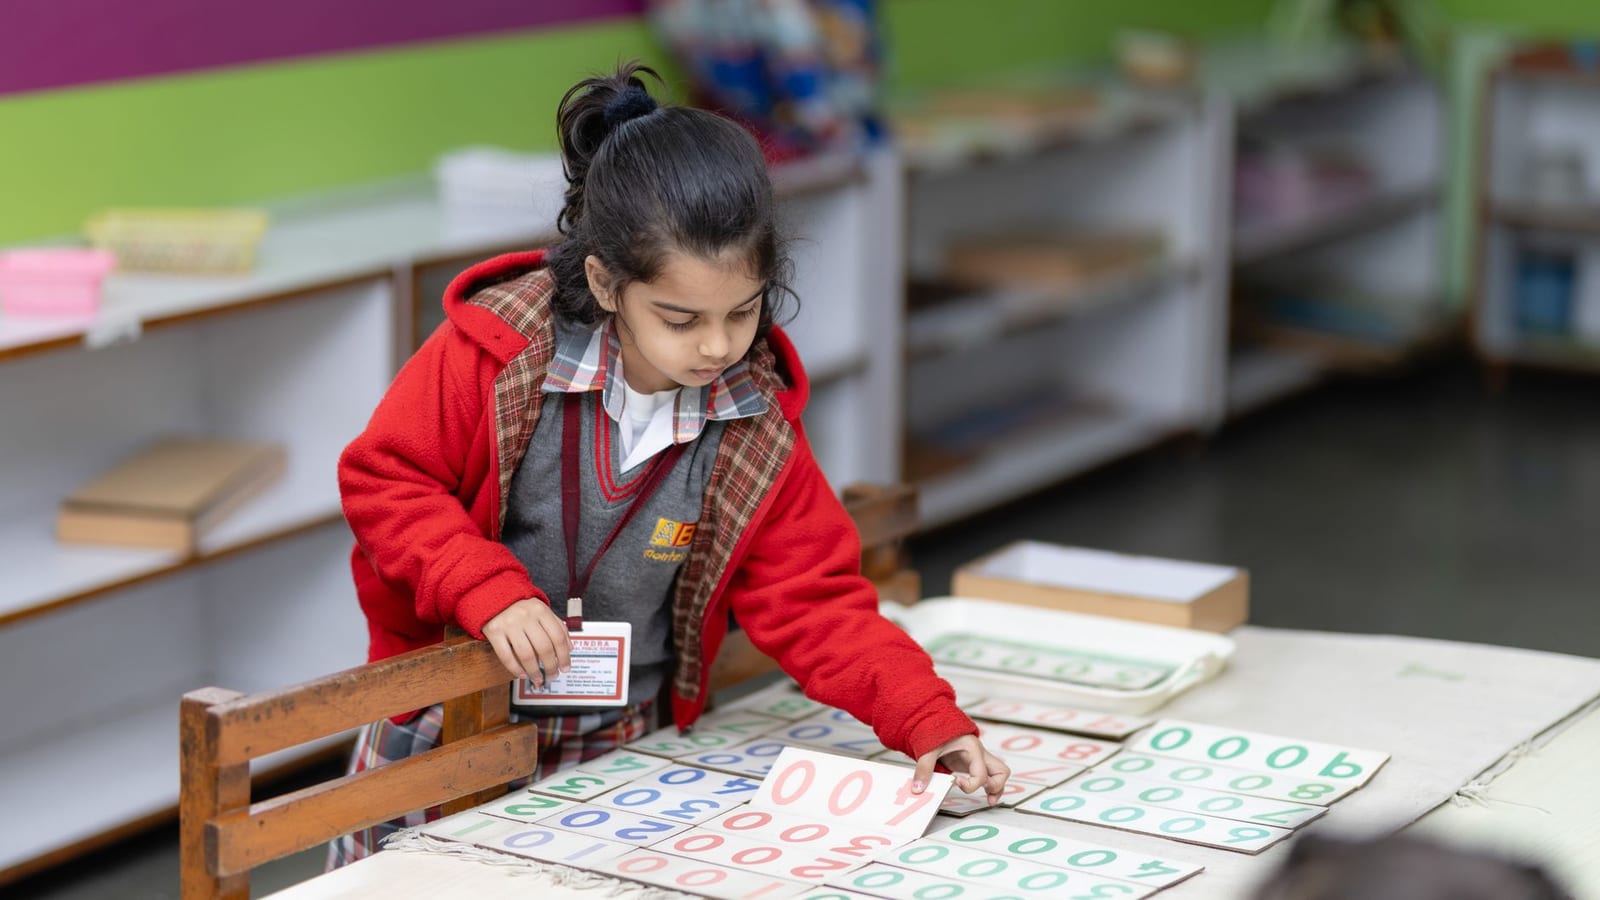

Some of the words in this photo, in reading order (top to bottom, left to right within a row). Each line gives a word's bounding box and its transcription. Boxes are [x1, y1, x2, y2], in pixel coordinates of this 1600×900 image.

[602, 756, 650, 773] 4
[1151, 727, 1362, 779] 9000
[547, 776, 605, 794] 3
[659, 769, 760, 795] 40
[771, 760, 934, 826] 400
[1111, 757, 1336, 800] 8000
[504, 797, 563, 816] 2
[613, 789, 720, 819] 30
[1040, 796, 1272, 843] 6000
[1080, 777, 1313, 824] 7000
[504, 830, 608, 860] 10
[560, 810, 675, 840] 20
[723, 812, 891, 857] 300
[674, 835, 851, 878] 200
[949, 825, 1180, 878] 4000
